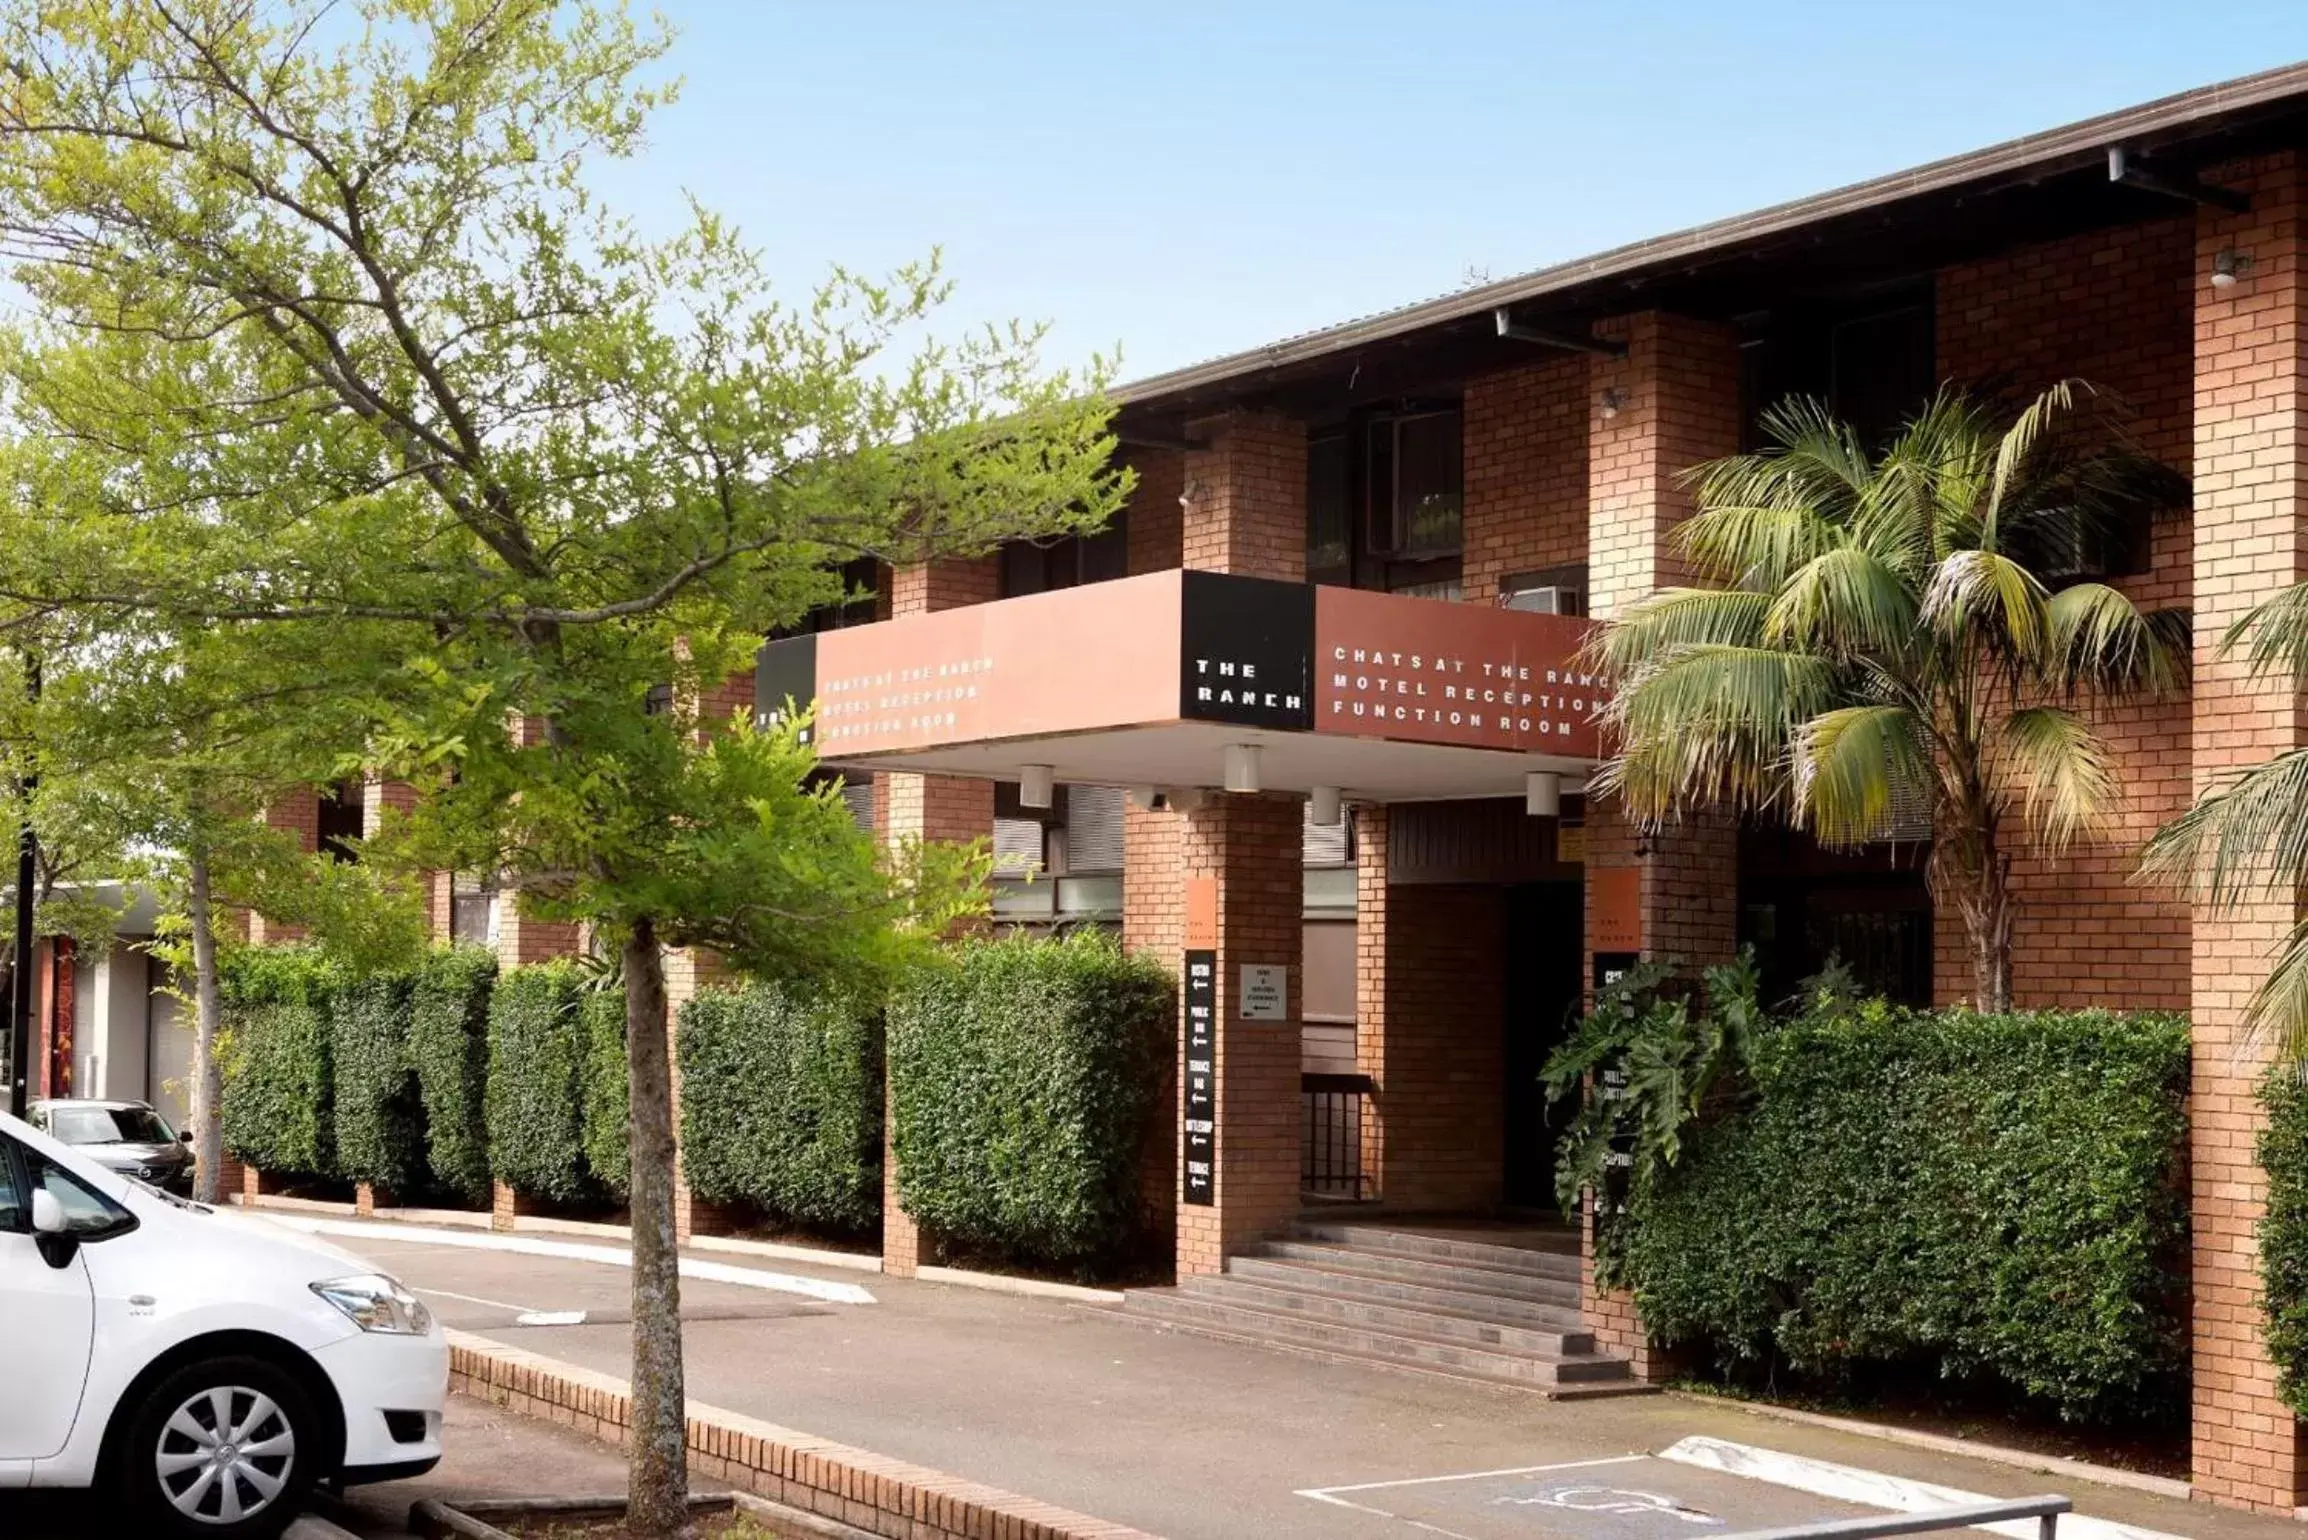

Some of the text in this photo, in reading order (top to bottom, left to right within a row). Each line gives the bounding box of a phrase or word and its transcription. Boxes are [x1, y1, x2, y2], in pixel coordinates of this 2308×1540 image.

[1196, 659, 1256, 678] THE
[1334, 647, 1610, 689] CHATS AT THE RANC
[1197, 687, 1301, 709] RANCH
[1333, 674, 1604, 713] MOTEL RECEPTION
[829, 719, 902, 738] UNCTION
[1333, 700, 1571, 736] FUNCTION ROOM
